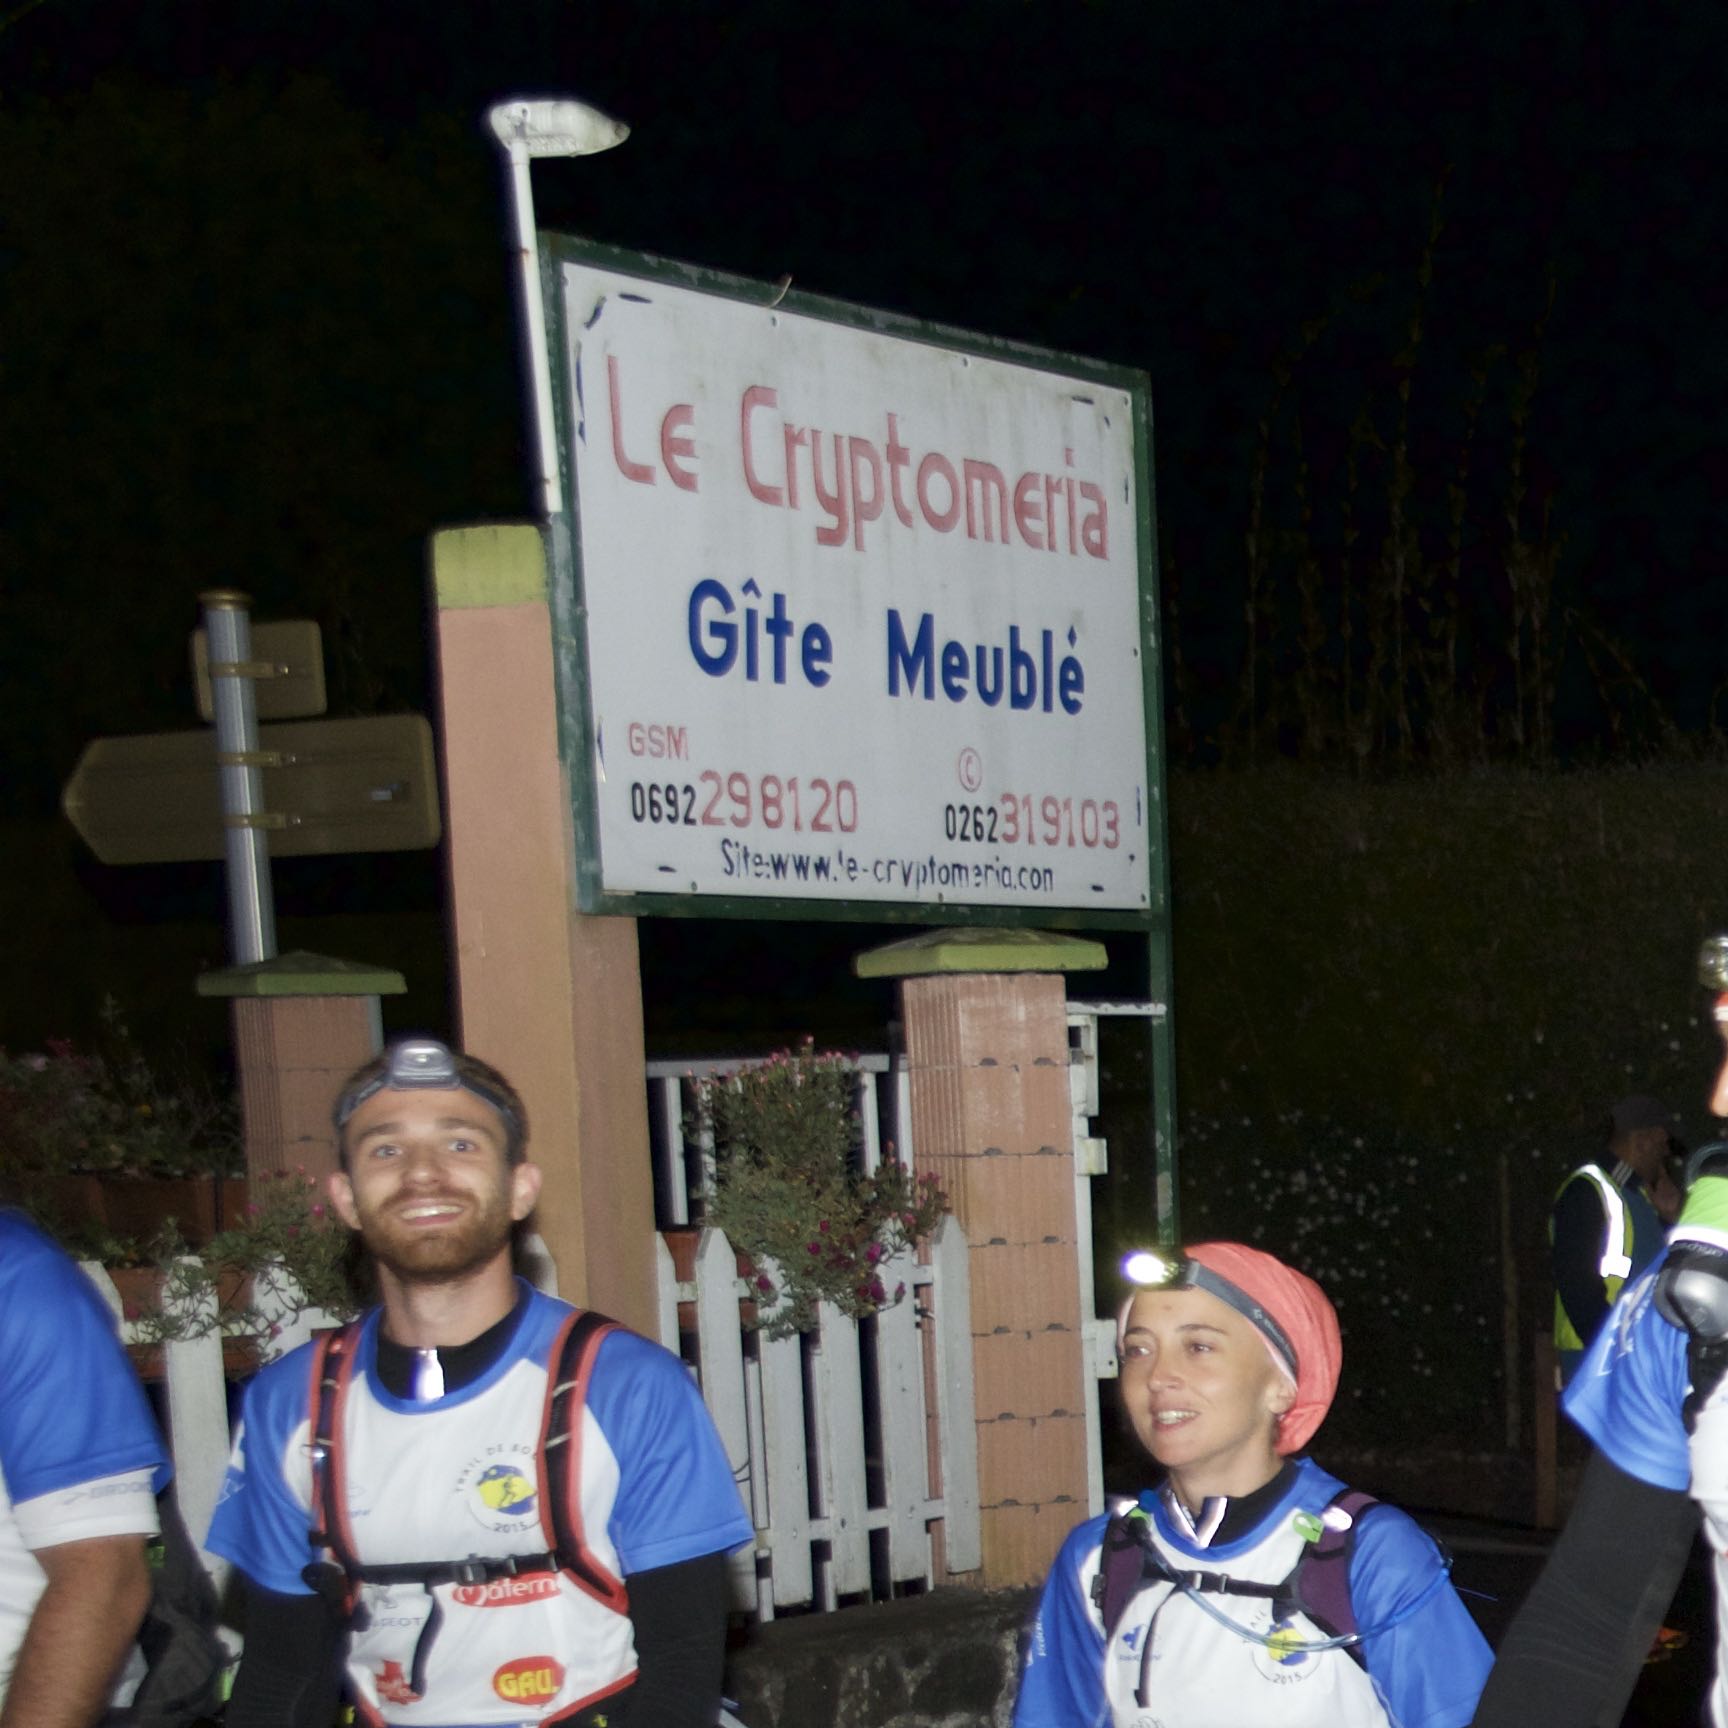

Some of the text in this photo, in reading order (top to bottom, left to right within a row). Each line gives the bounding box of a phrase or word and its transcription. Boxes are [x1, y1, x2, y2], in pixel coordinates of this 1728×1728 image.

[606, 354, 1110, 562] Le Cryptomeria
[687, 576, 1085, 716] Gîte Meublé
[627, 721, 690, 762] GSM
[1271, 1672, 1303, 1685] 2015
